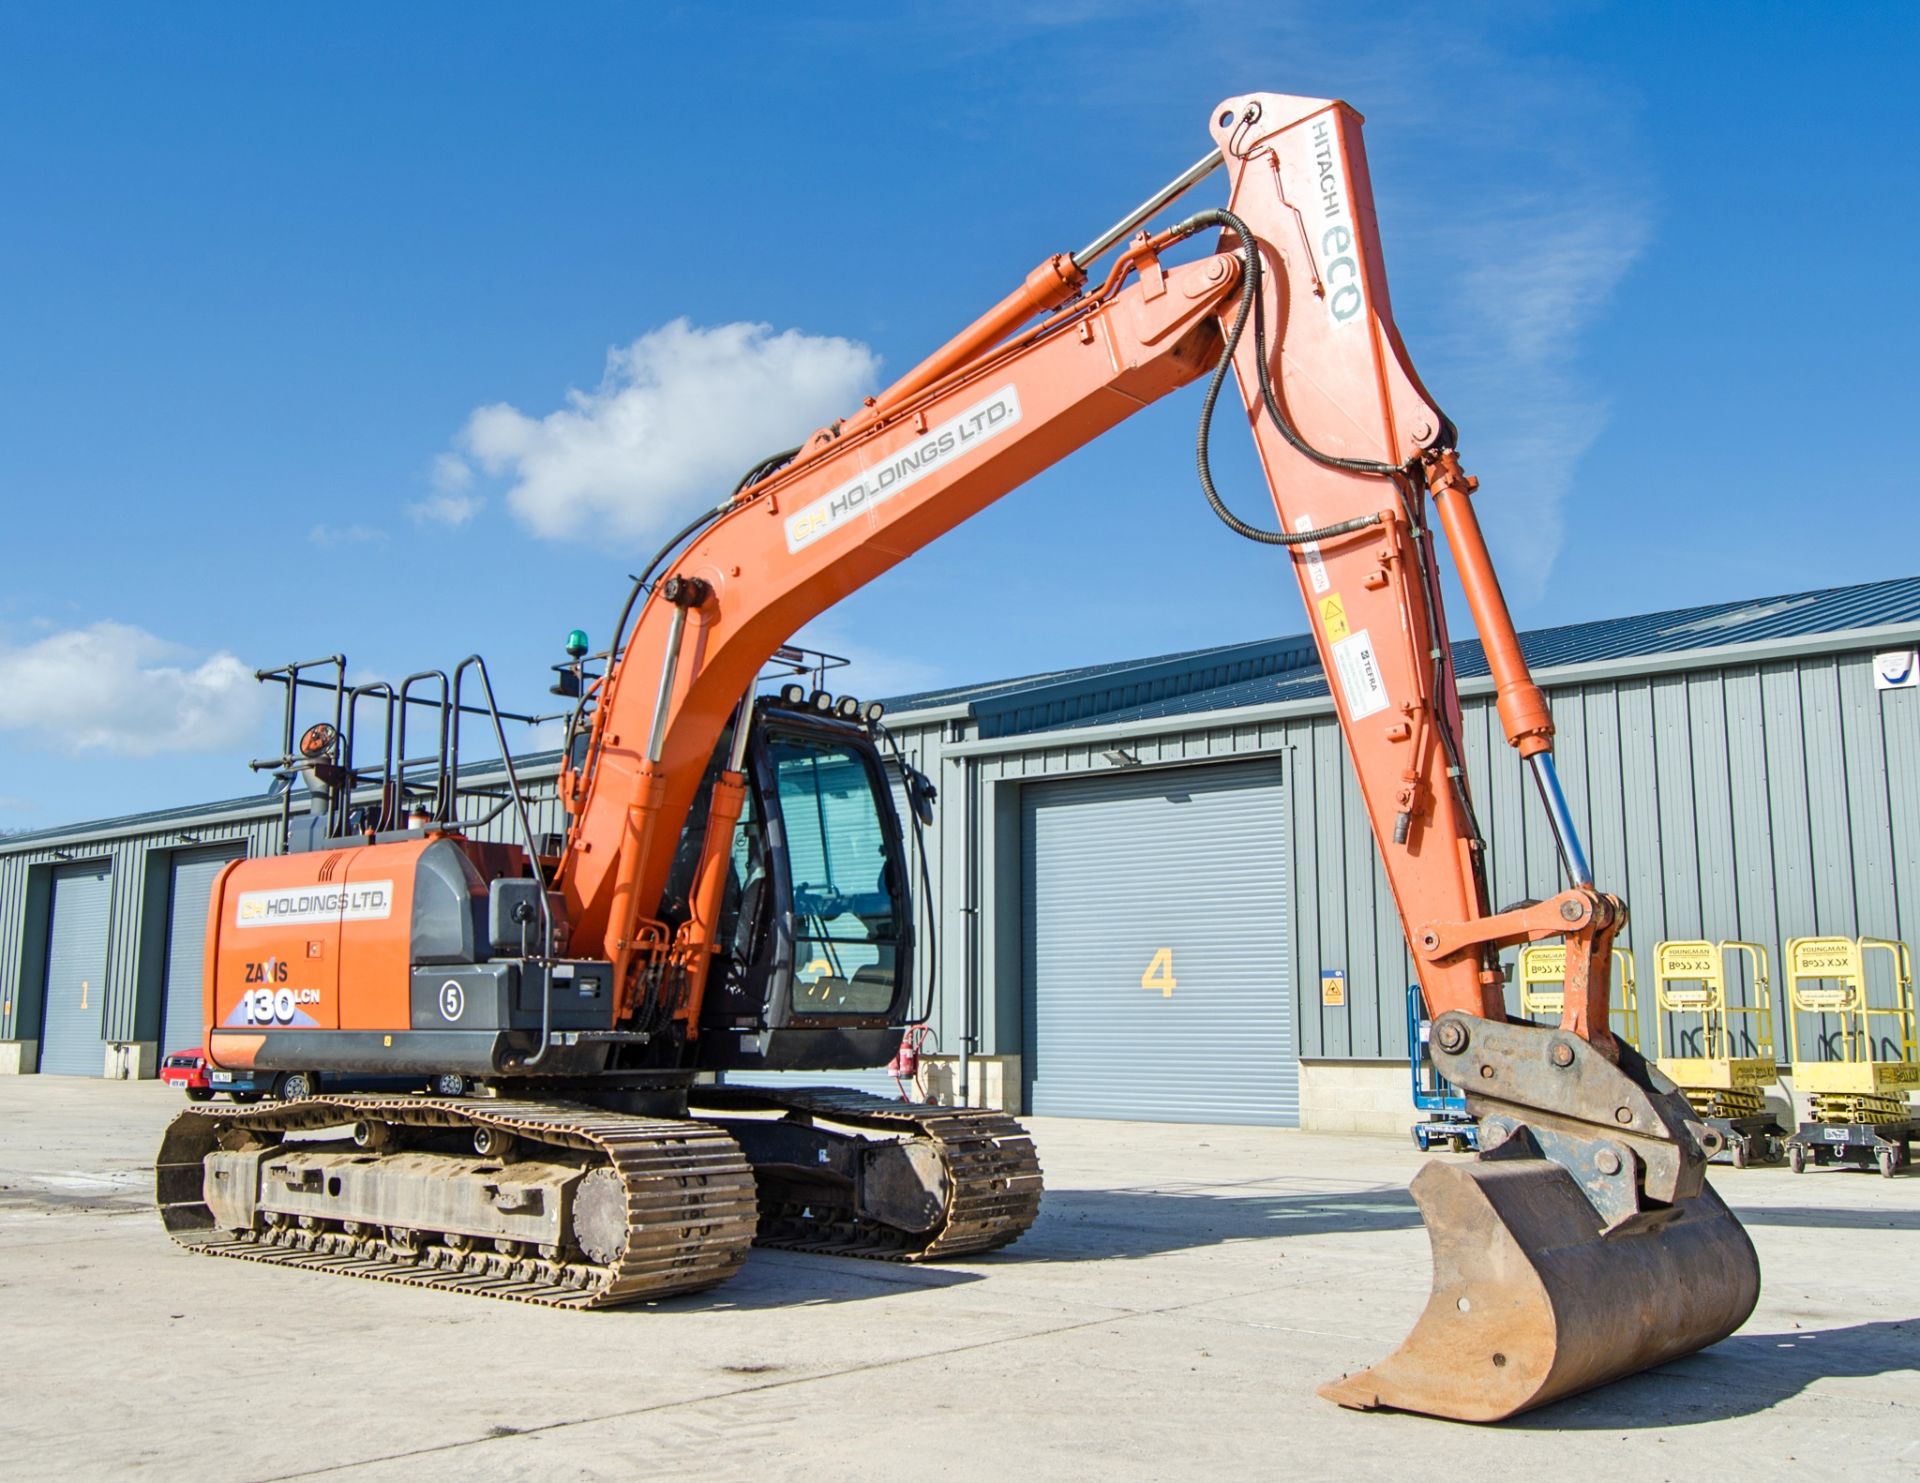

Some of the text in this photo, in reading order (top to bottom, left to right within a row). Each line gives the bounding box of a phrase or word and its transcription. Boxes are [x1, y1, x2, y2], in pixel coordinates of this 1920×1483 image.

[1312, 120, 1340, 219] HITACHI
[1321, 224, 1362, 323] eco
[793, 400, 1015, 541] CH HOLDINGS LTD.
[1364, 660, 1377, 691] TEFRA
[266, 892, 349, 915] HOLDINGS
[352, 890, 388, 909] LTD.
[1802, 945, 1848, 953] YOUNGMAN
[245, 956, 288, 984] ZAXIS
[1141, 947, 1177, 998] 4
[80, 981, 88, 1009] 1
[243, 987, 321, 1025] 130 LCN
[446, 989, 457, 1012] 5
